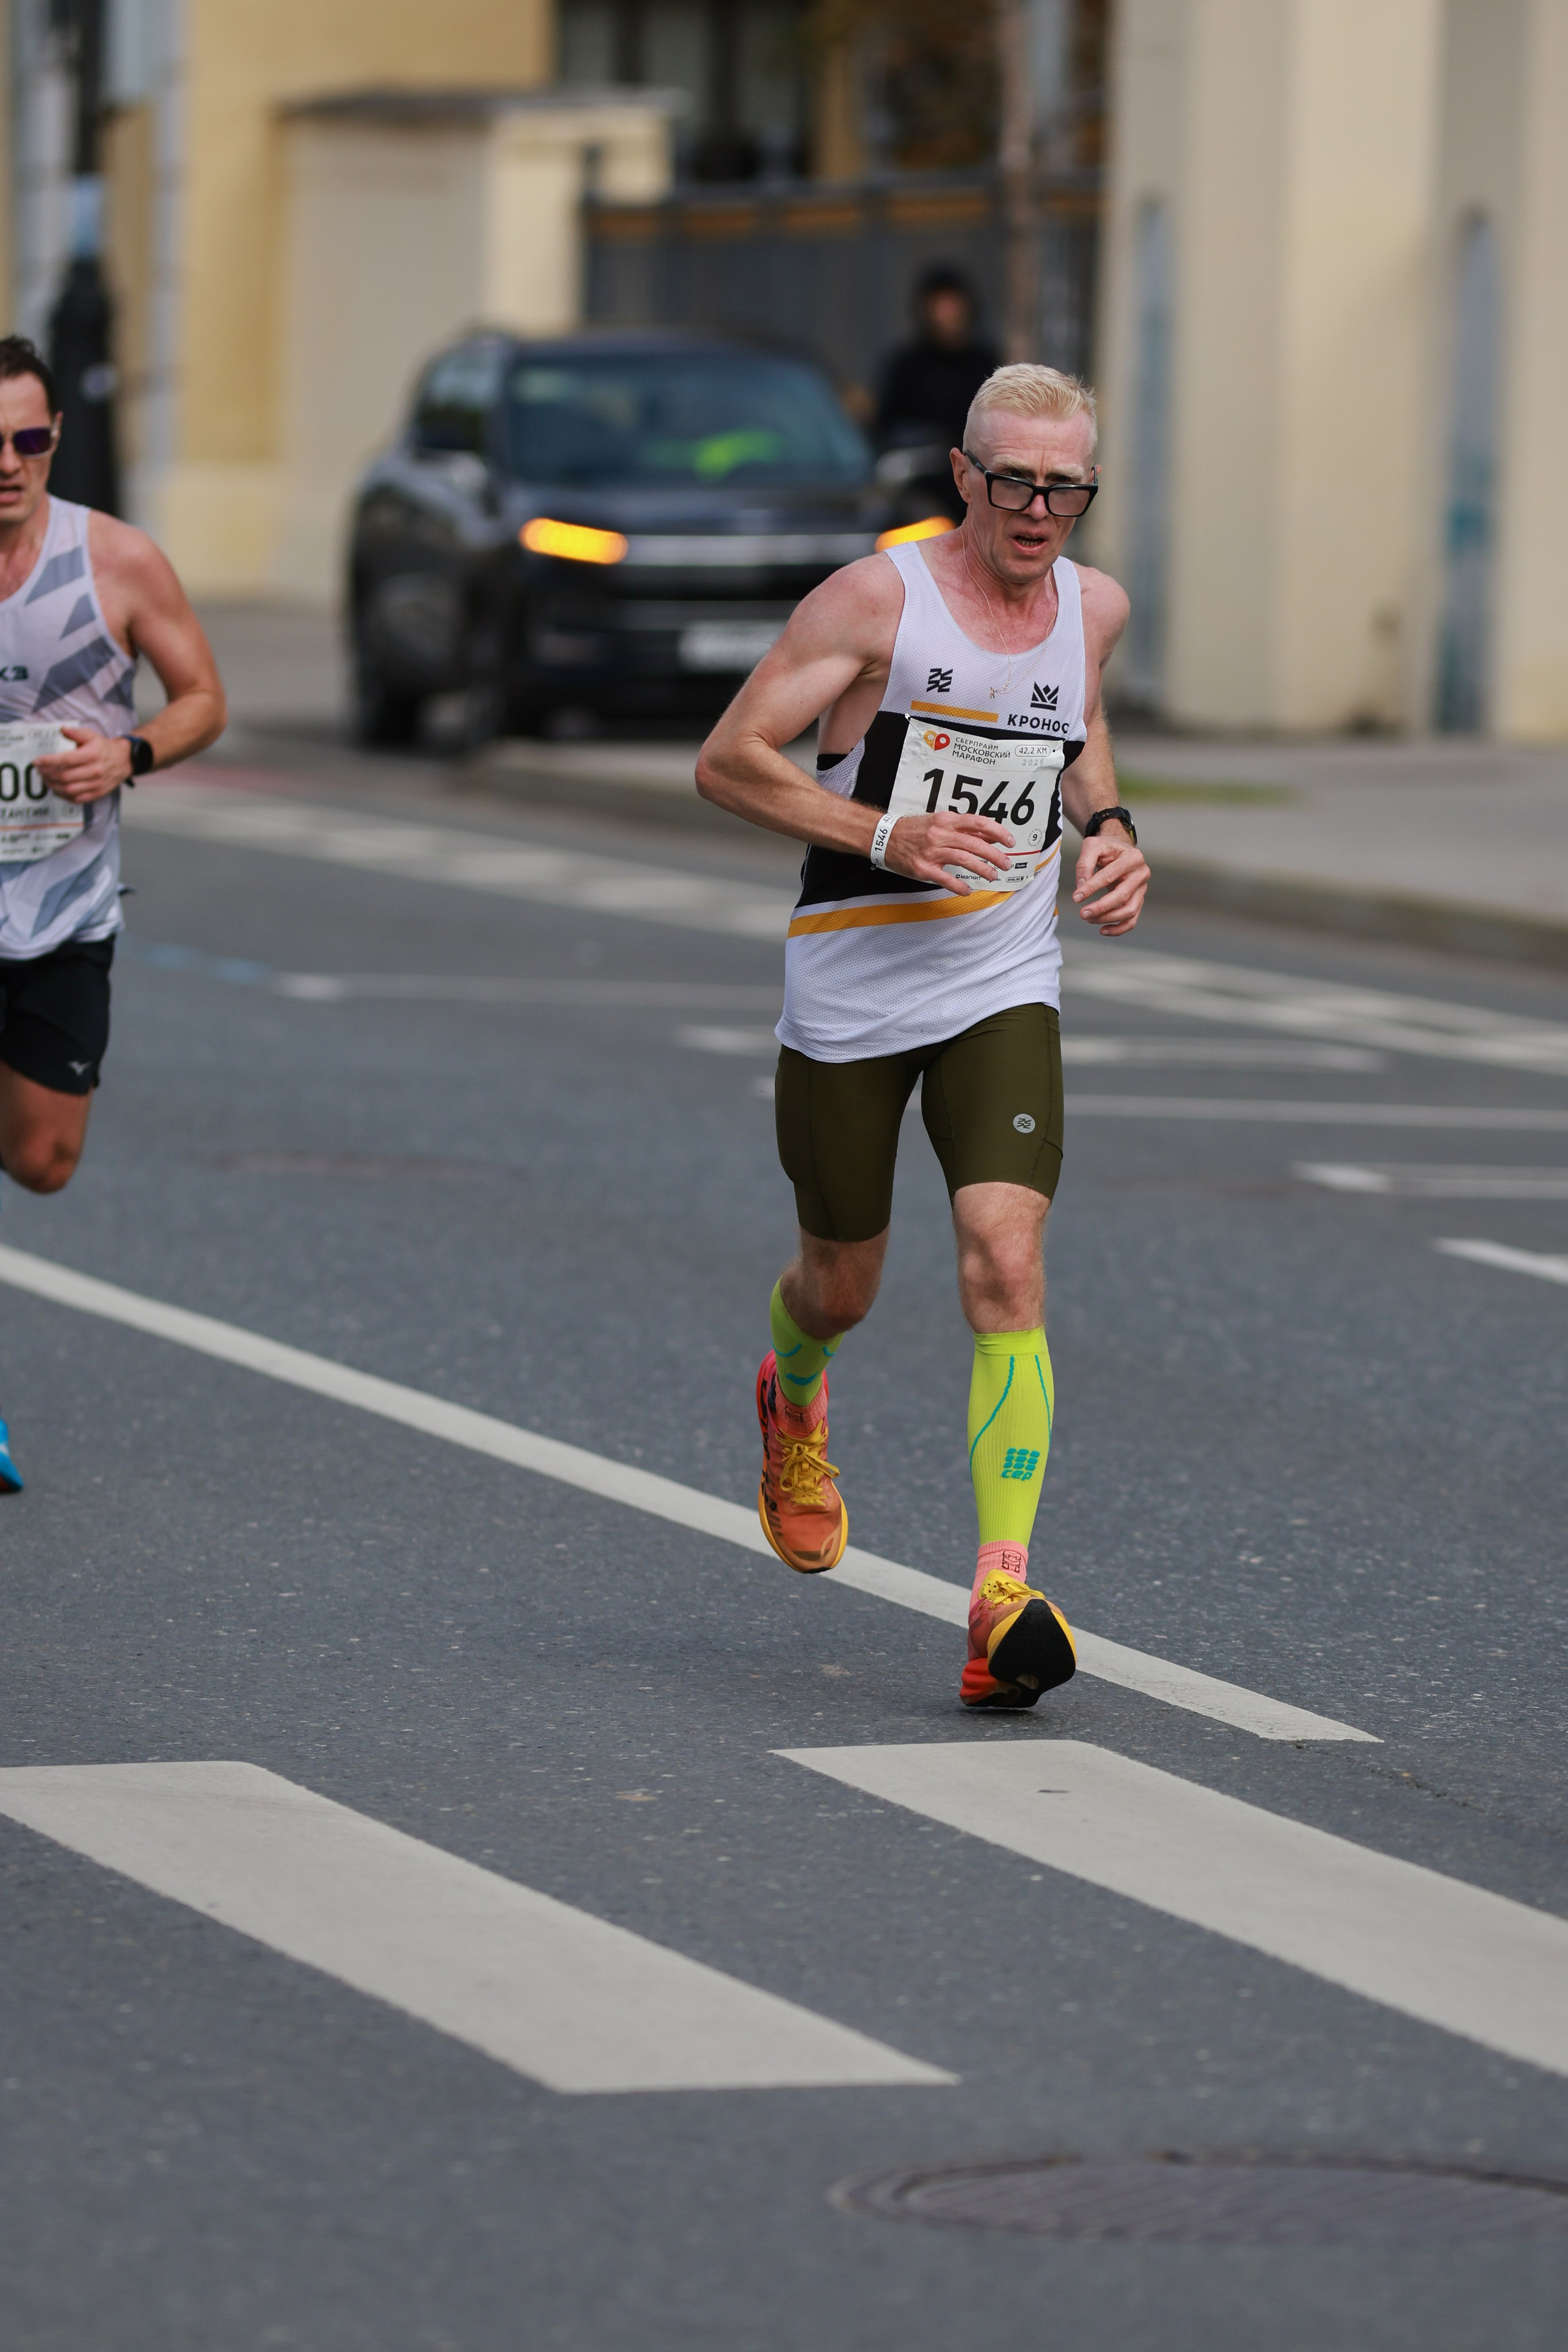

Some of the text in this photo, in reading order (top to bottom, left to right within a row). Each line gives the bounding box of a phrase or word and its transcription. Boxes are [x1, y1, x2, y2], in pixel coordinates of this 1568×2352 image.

[1007, 714, 1069, 734] КРОНОС
[954, 743, 1011, 759] МОСКОВСКИЙ
[956, 737, 999, 751] СБЕРПРАЙМ
[952, 750, 996, 766] МАРАФОН
[923, 768, 1036, 826] 1546
[875, 829, 888, 851] 1546
[1001, 1469, 1033, 1481] cep
